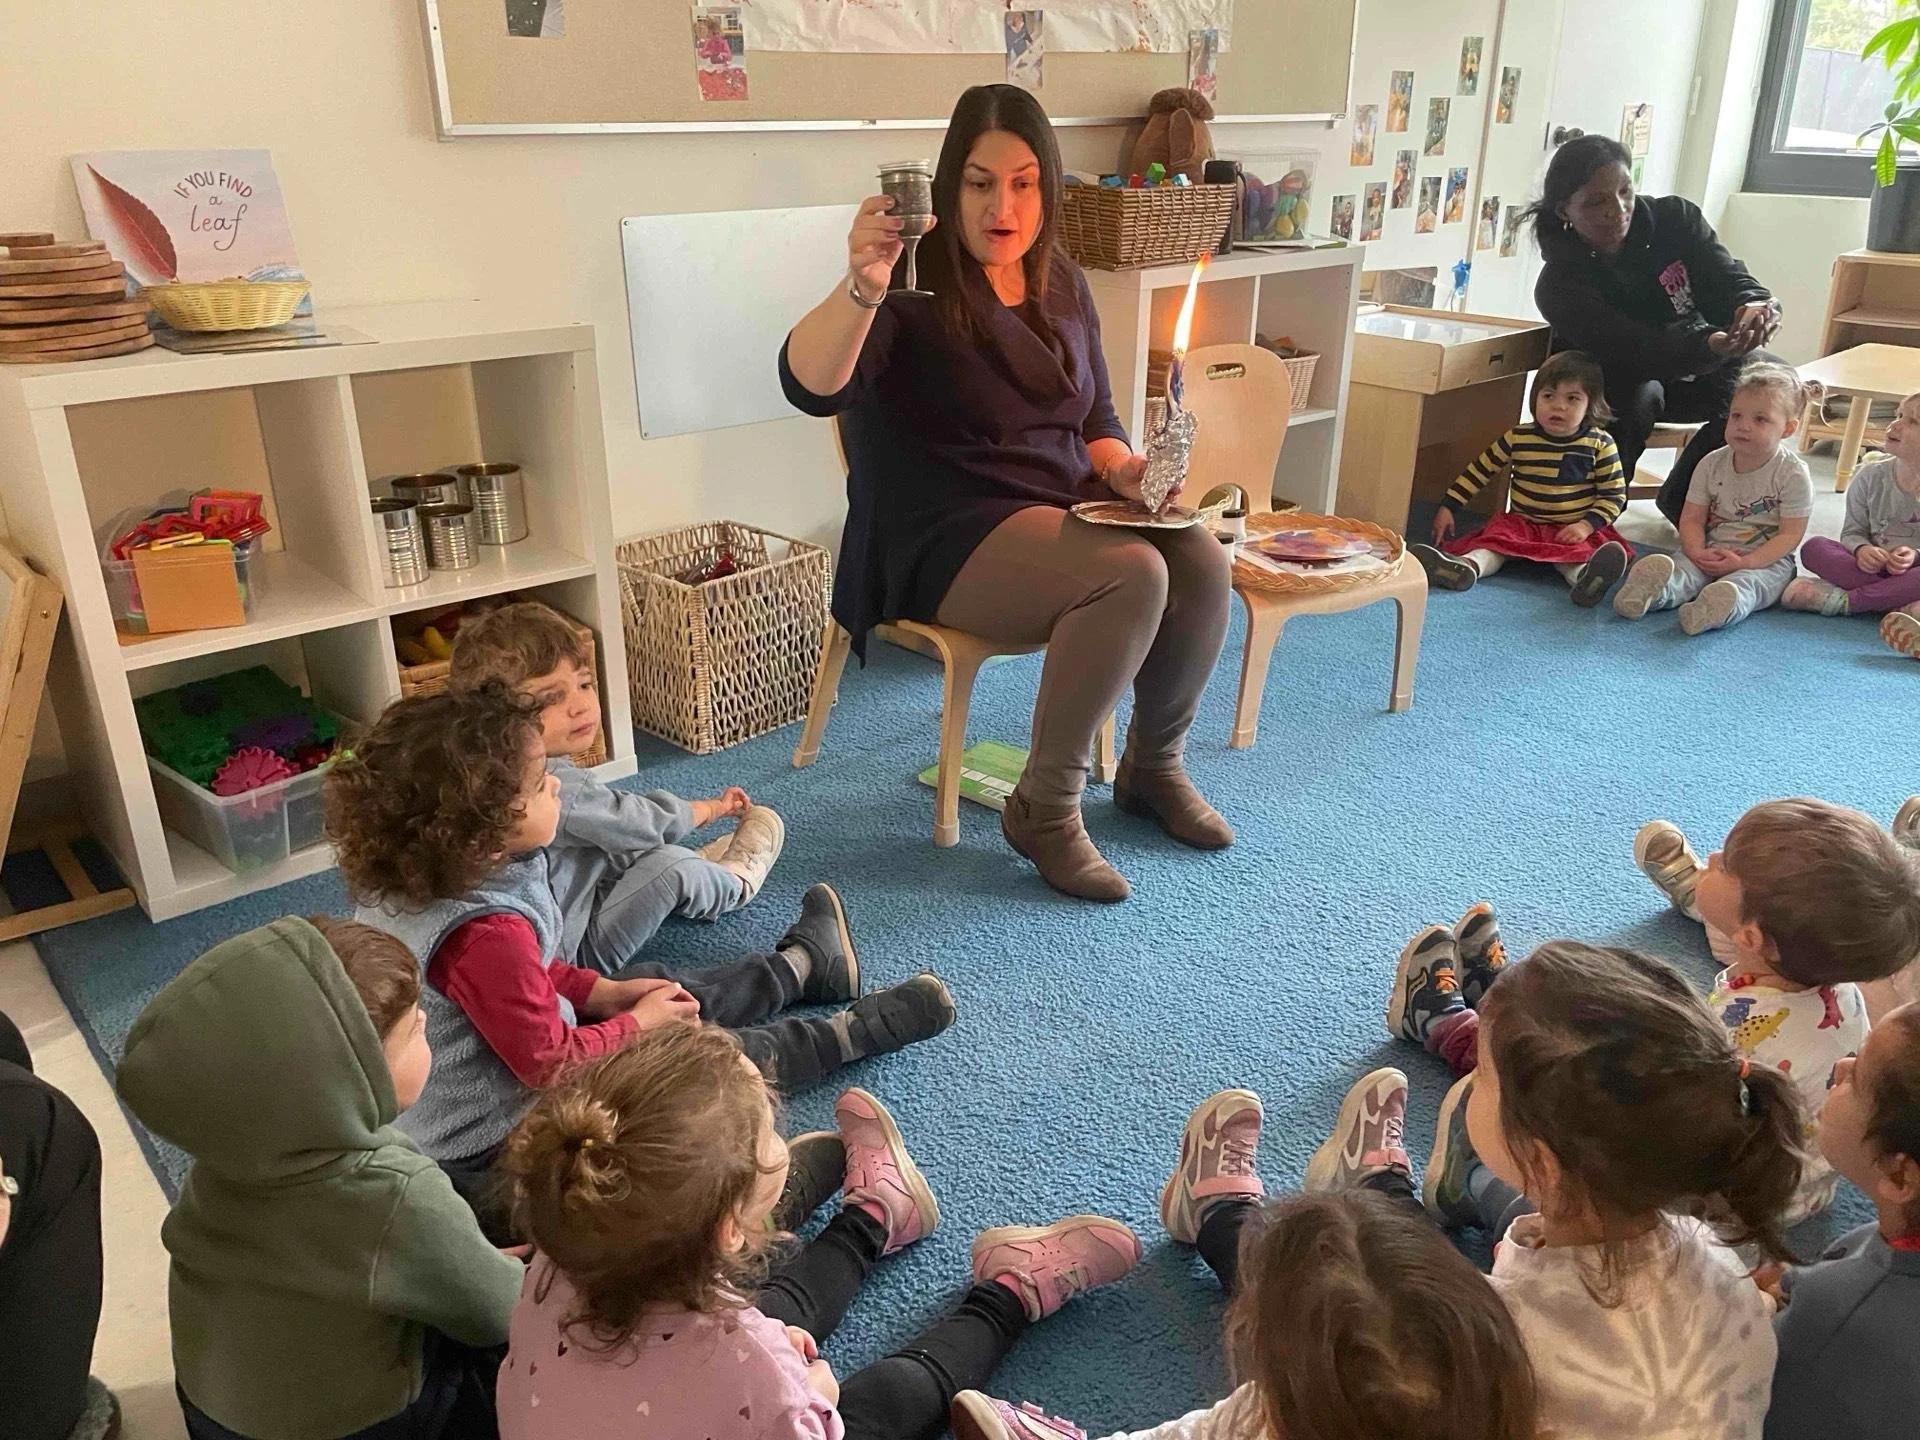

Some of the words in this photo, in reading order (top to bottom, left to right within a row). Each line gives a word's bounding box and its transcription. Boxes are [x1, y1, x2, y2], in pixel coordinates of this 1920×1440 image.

[173, 182, 190, 199] IF
[184, 171, 215, 189] YOU
[219, 172, 253, 198] FIND
[208, 195, 223, 206] a
[190, 203, 248, 252] leaf
